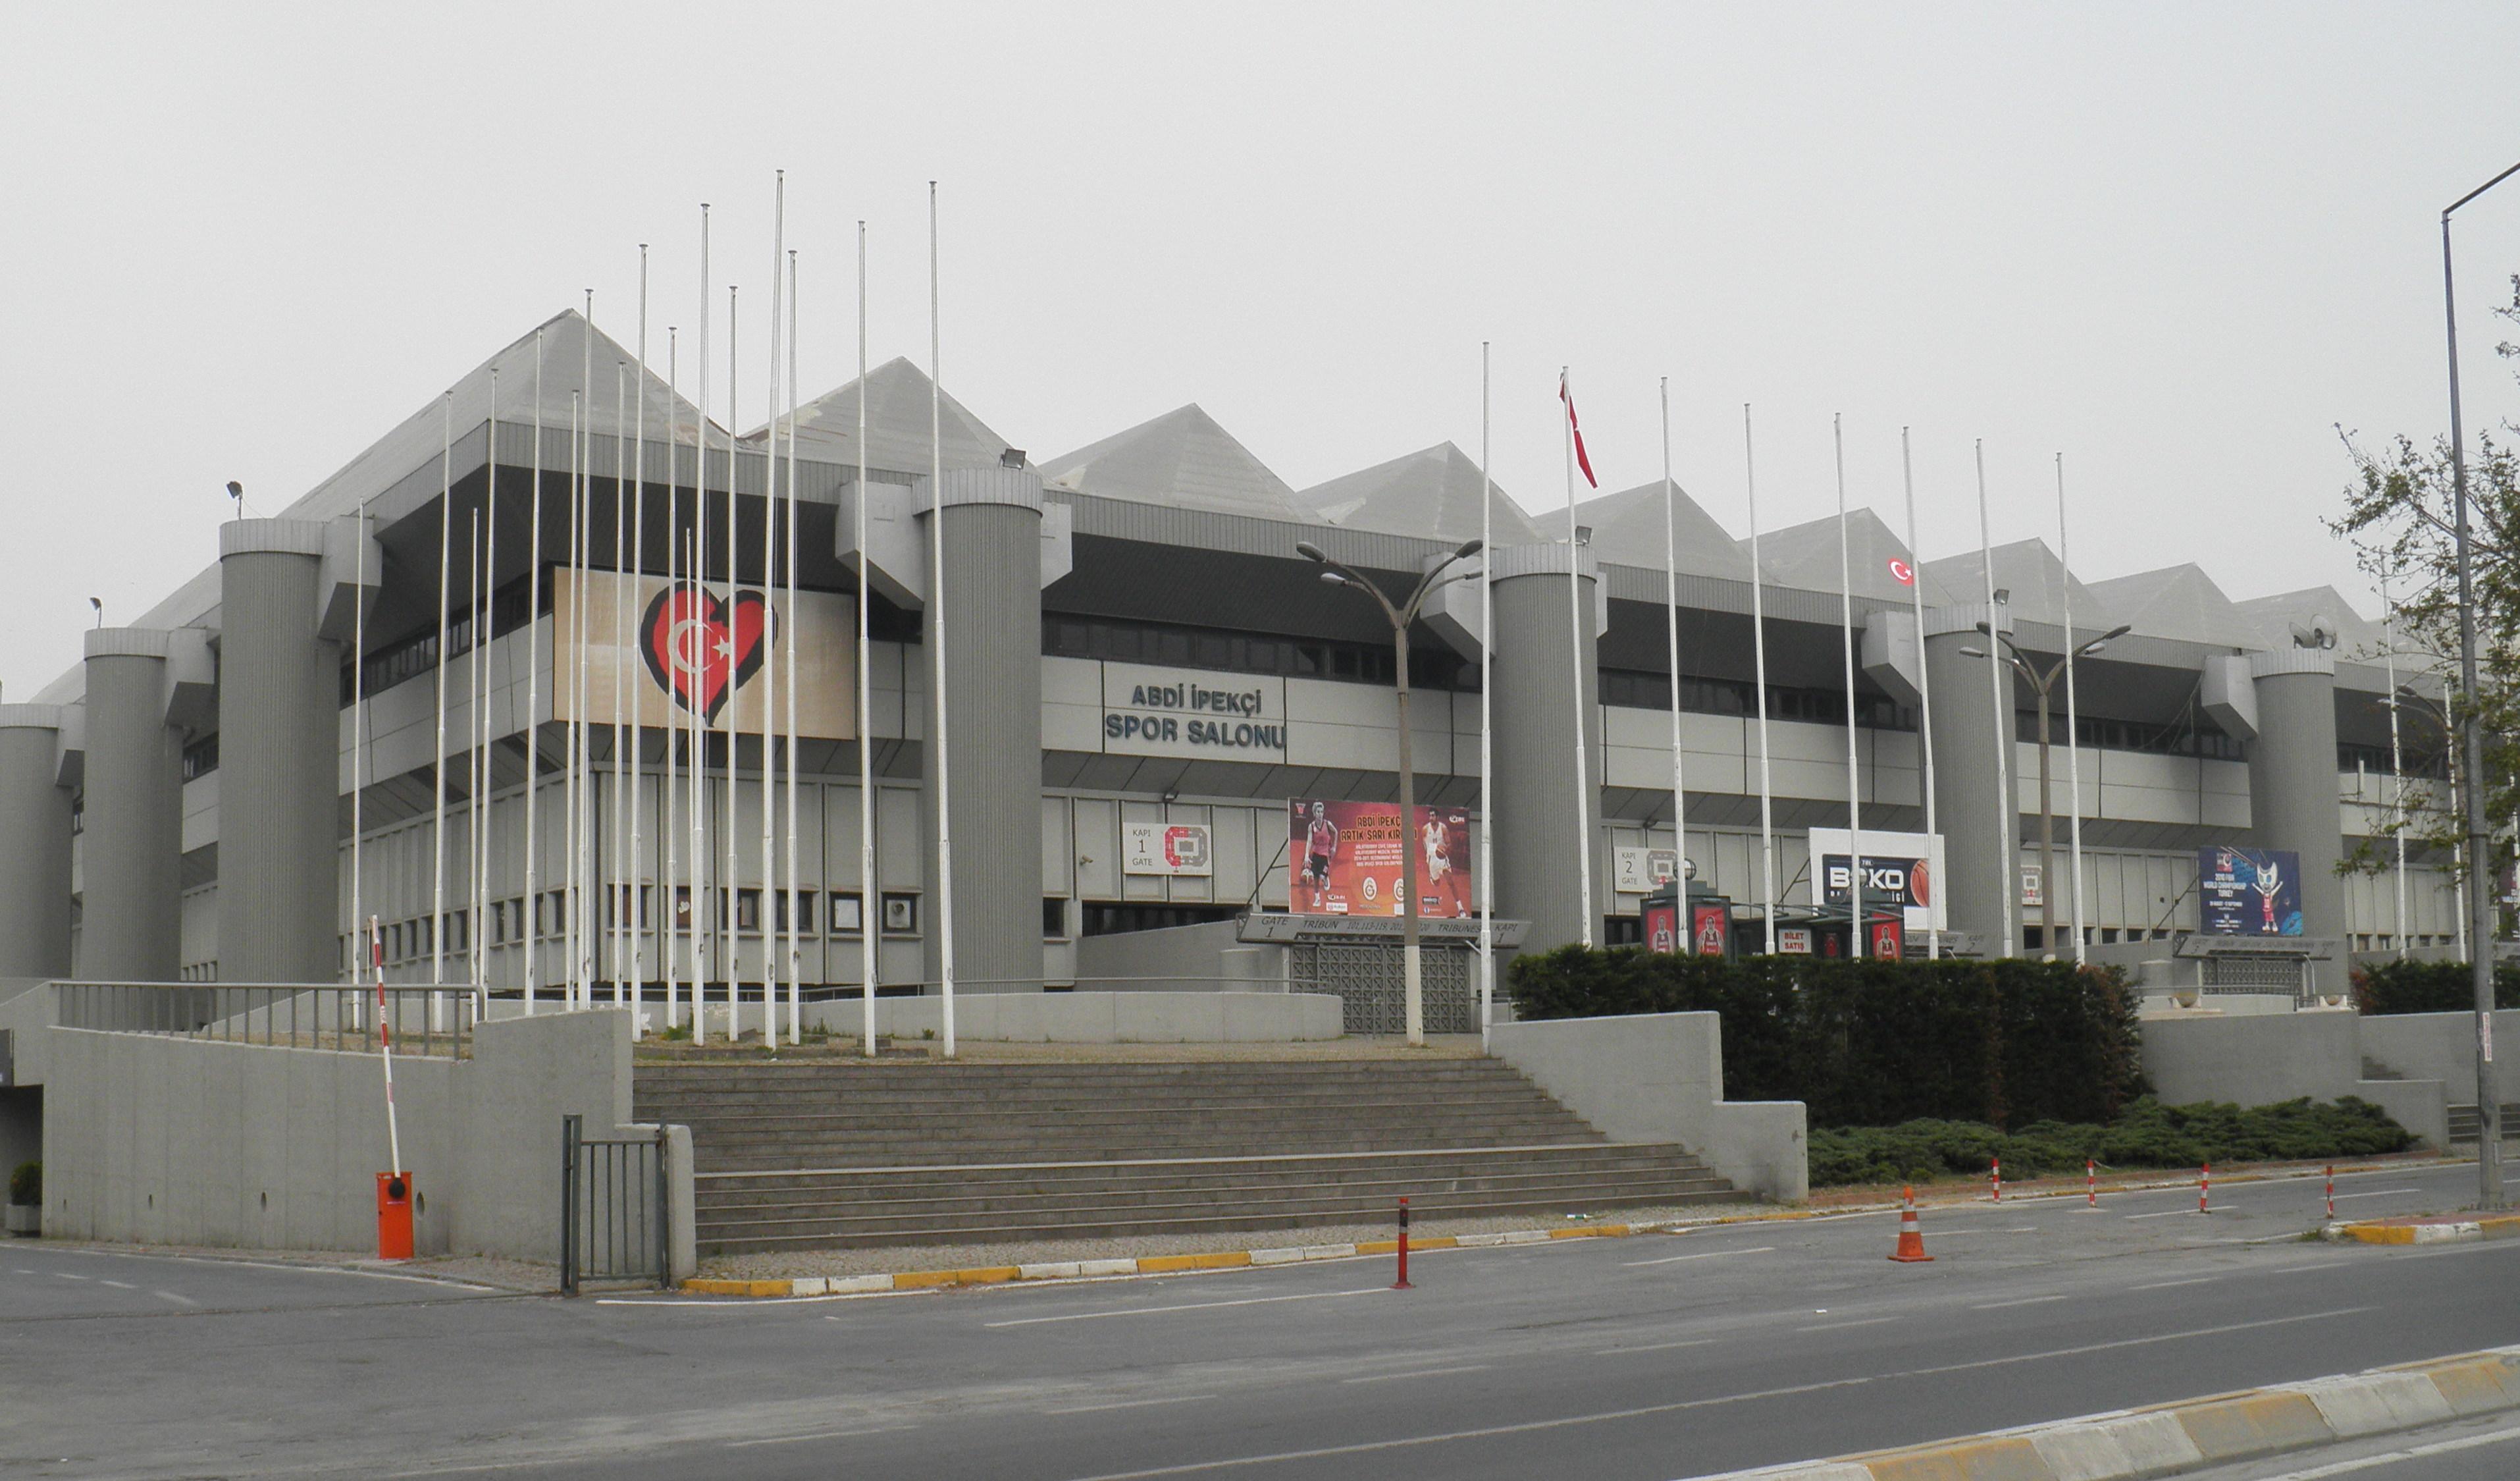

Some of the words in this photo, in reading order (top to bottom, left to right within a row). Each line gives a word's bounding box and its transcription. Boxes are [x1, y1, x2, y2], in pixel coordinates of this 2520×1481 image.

[1132, 683, 1184, 708] ABDİ
[1191, 684, 1261, 718] İPEKÇİ
[1106, 714, 1178, 741] SPOR
[1188, 720, 1286, 749] SALONU
[1357, 814, 1375, 828] ABDİ
[1341, 830, 1364, 840] ARTIK
[1367, 830, 1385, 840] SARI
[1138, 839, 1145, 853] 1
[1625, 861, 1632, 873] 2
[1830, 867, 1904, 890] BKO
[1261, 916, 1290, 925] GATE
[1265, 927, 1274, 938] 1
[1494, 923, 1518, 932] KAPI
[1497, 932, 1505, 943] 1
[1785, 942, 1805, 952] SATIŞ
